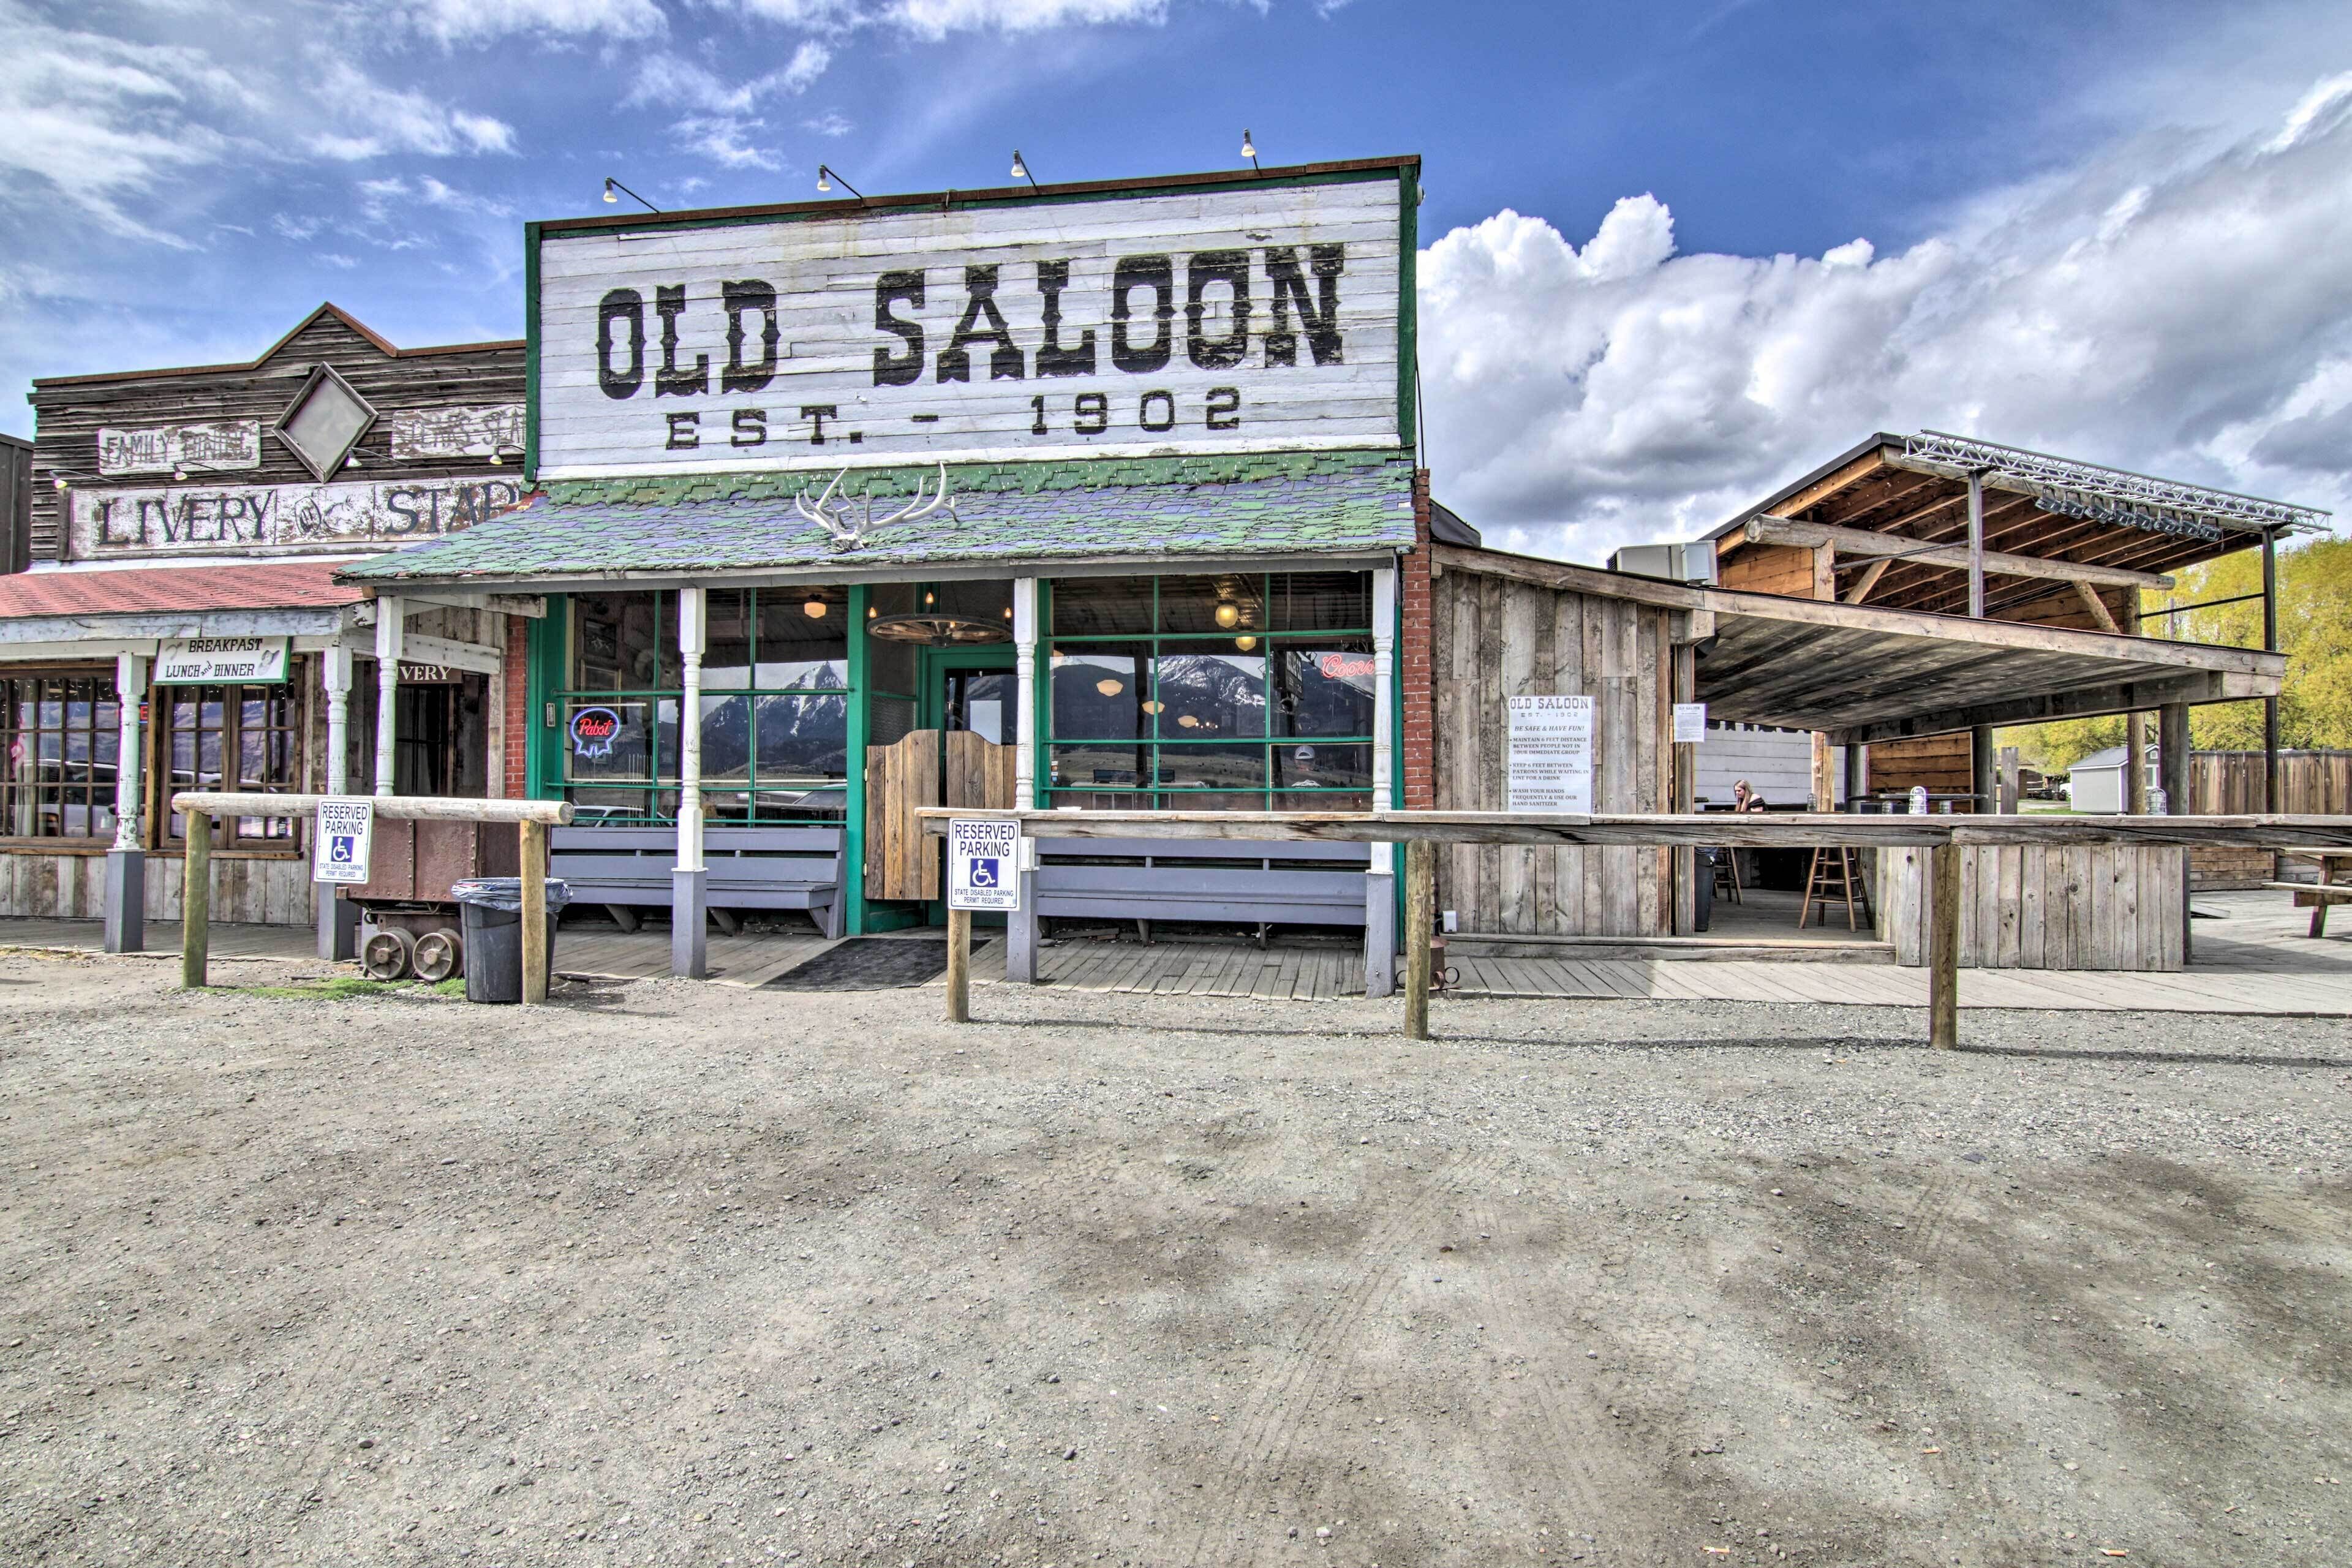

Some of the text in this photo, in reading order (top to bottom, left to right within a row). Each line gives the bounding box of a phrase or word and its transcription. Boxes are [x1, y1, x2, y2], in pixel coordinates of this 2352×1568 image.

[596, 242, 1344, 399] OLD SALOON
[666, 405, 863, 450] EST.
[1031, 386, 1241, 435] 1902
[106, 434, 170, 464] FAMILY
[99, 489, 276, 545] LIVERY
[189, 638, 263, 653] BREAKFAST
[165, 661, 255, 677] LUNCH and DINNER
[397, 665, 451, 680] VERY
[1322, 654, 1374, 678] Coors
[1510, 698, 1589, 709] OLD SALOON
[579, 718, 613, 736] Pabst
[322, 805, 368, 820] RESERVED
[325, 821, 363, 835] PARKING
[955, 824, 1015, 840] RESERVED
[960, 841, 1010, 857] PARKING
